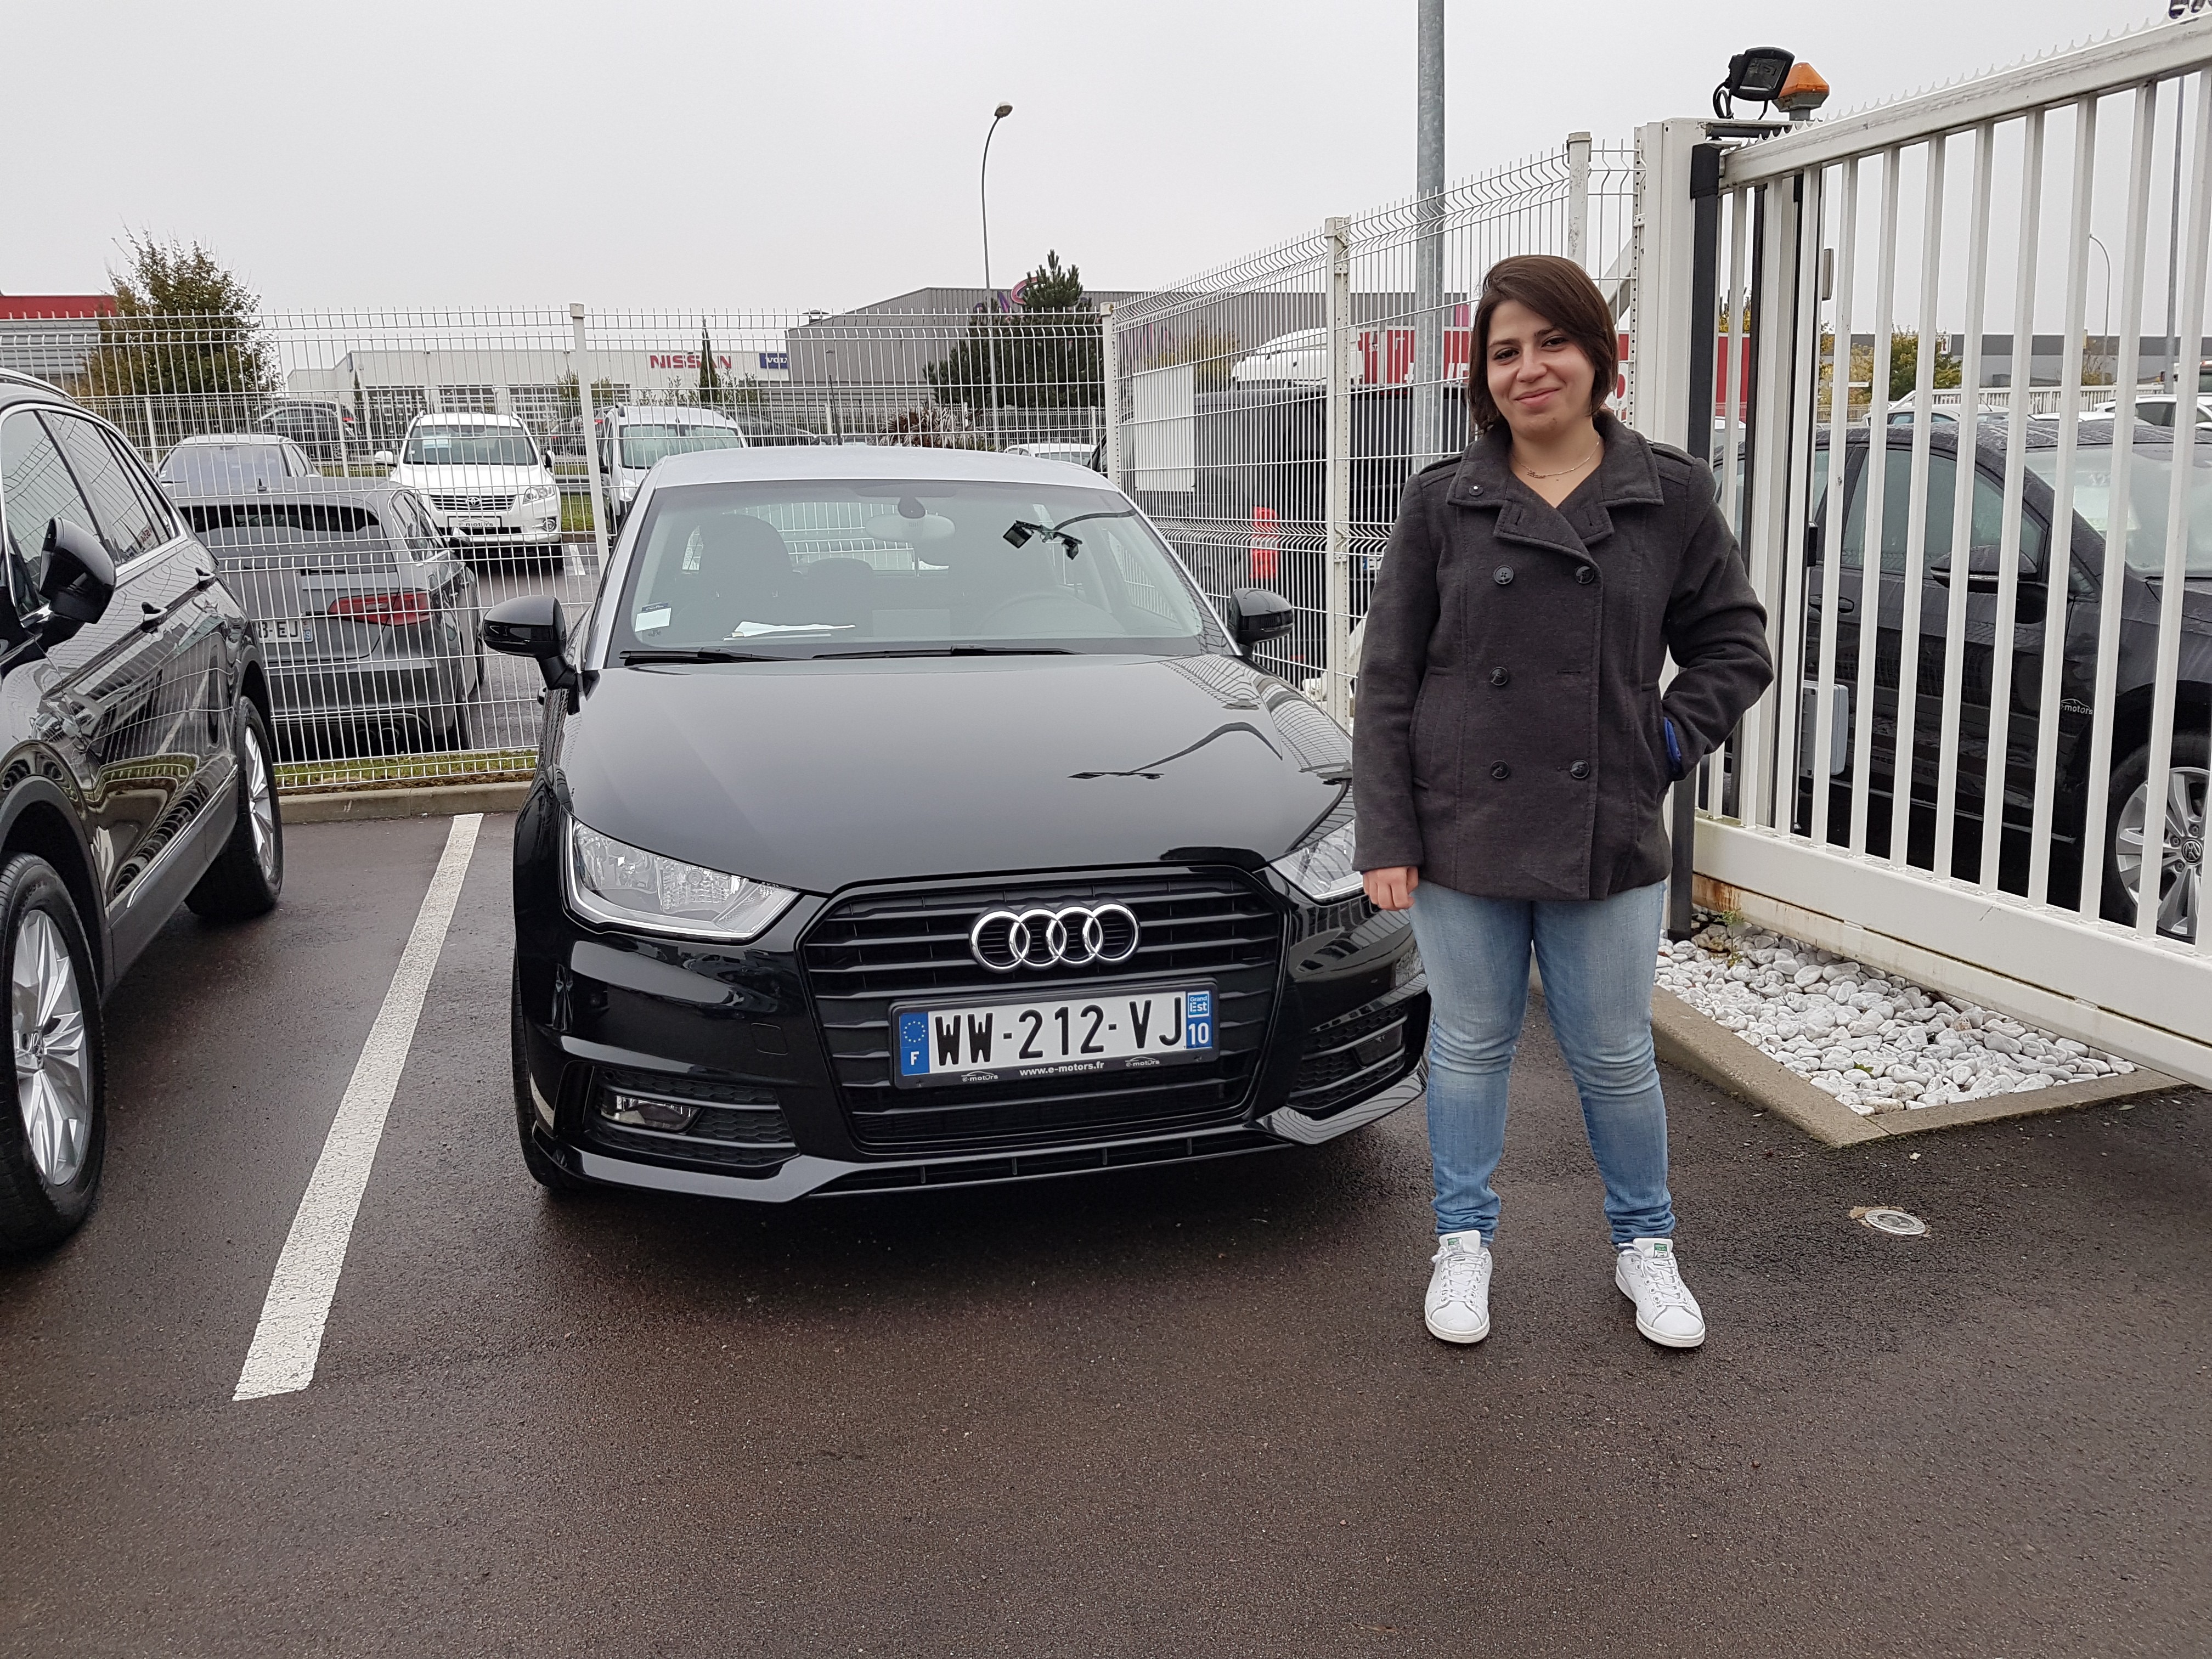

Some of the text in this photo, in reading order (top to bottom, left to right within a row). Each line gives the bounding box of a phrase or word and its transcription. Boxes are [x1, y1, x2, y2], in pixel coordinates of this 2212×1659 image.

[650, 355, 732, 369] NISSN
[1189, 1002, 1207, 1012] Est
[935, 997, 1182, 1066] WW-212-VJ
[1188, 1022, 1209, 1045] 10
[910, 1051, 919, 1065] F
[1019, 1061, 1104, 1076] www.e-motors.fr
